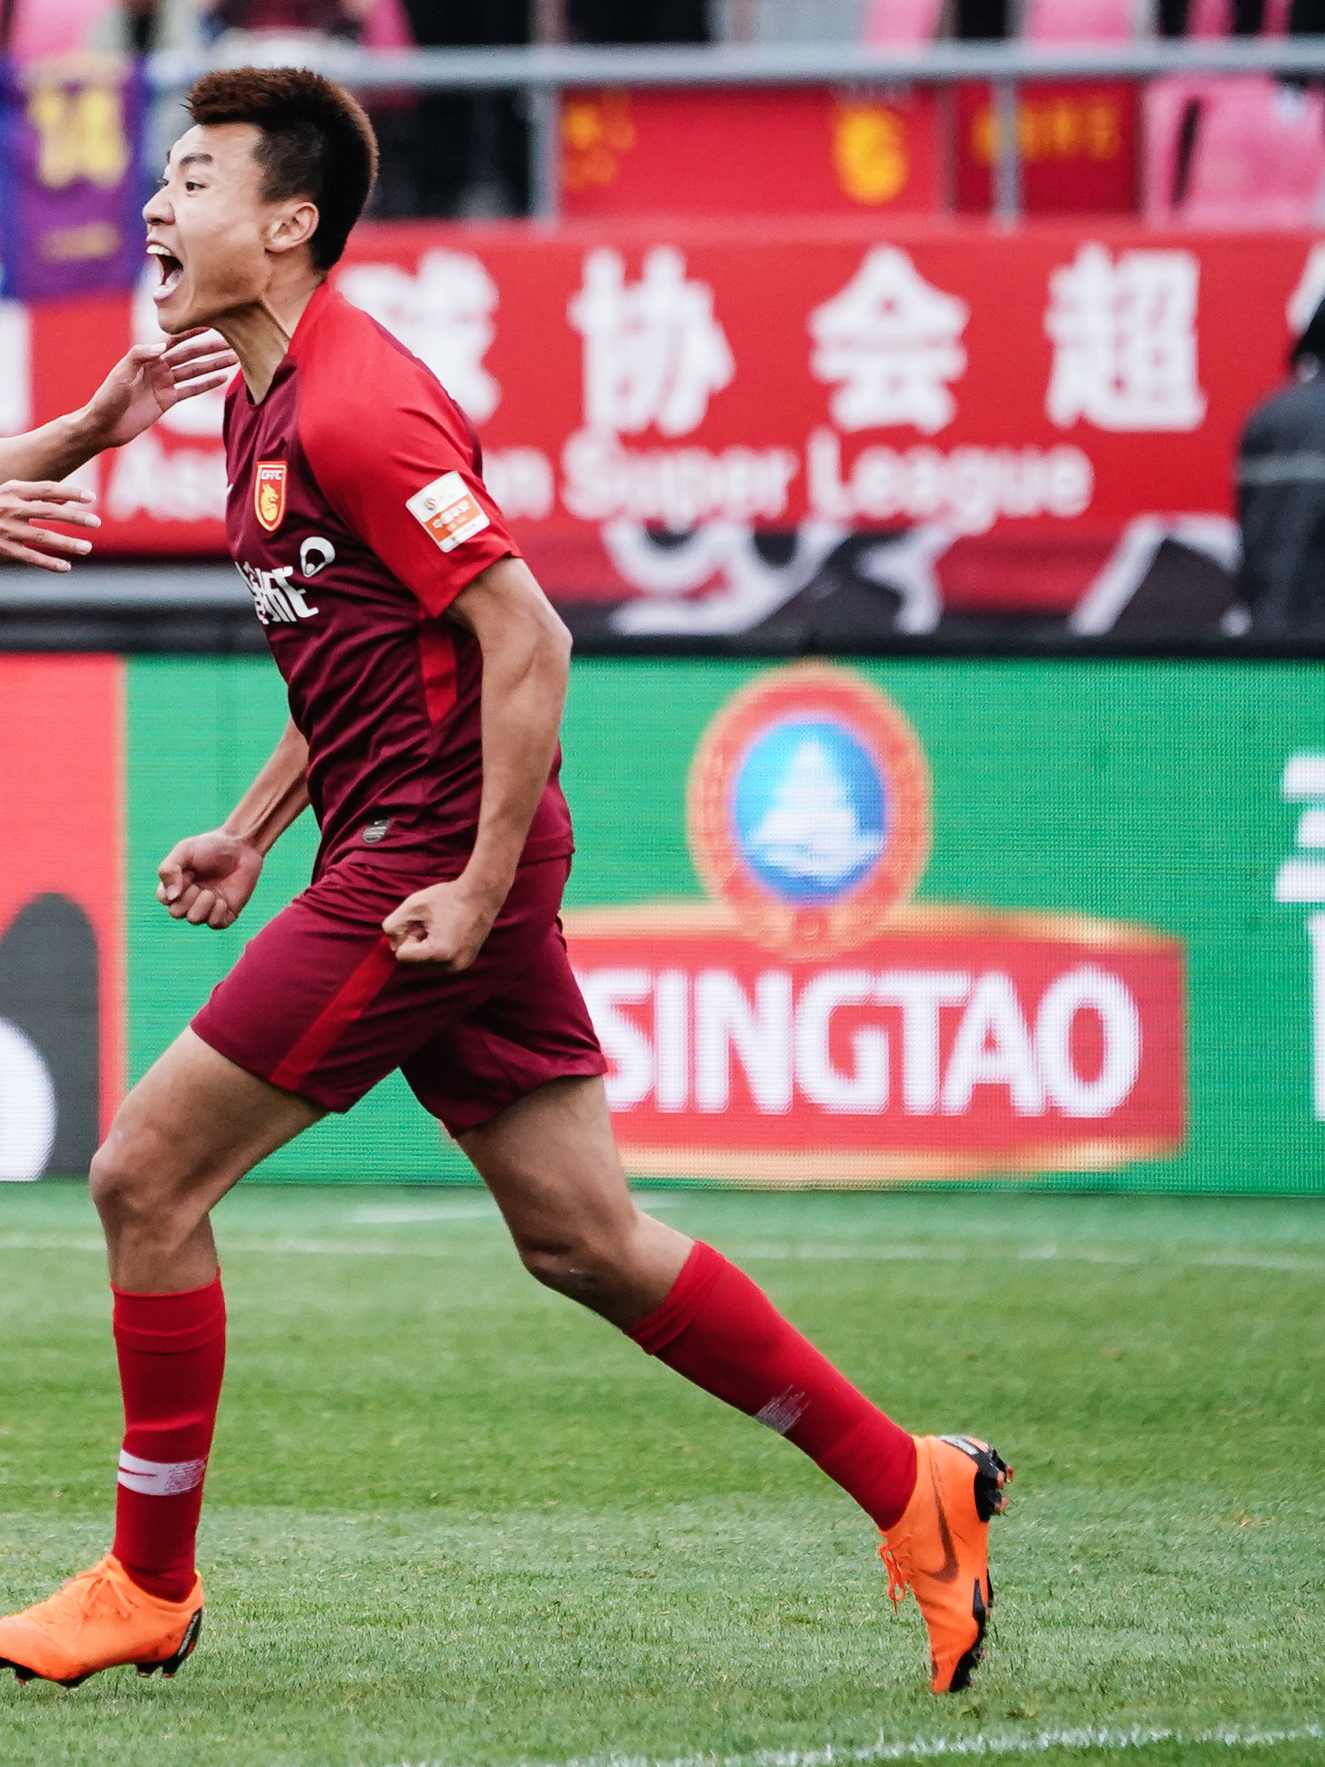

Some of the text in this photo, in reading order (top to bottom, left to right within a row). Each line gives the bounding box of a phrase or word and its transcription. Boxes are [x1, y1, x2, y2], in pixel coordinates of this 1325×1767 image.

[561, 428, 797, 533] Super
[806, 426, 1094, 536] League
[574, 964, 1142, 1118] SINGTAO
